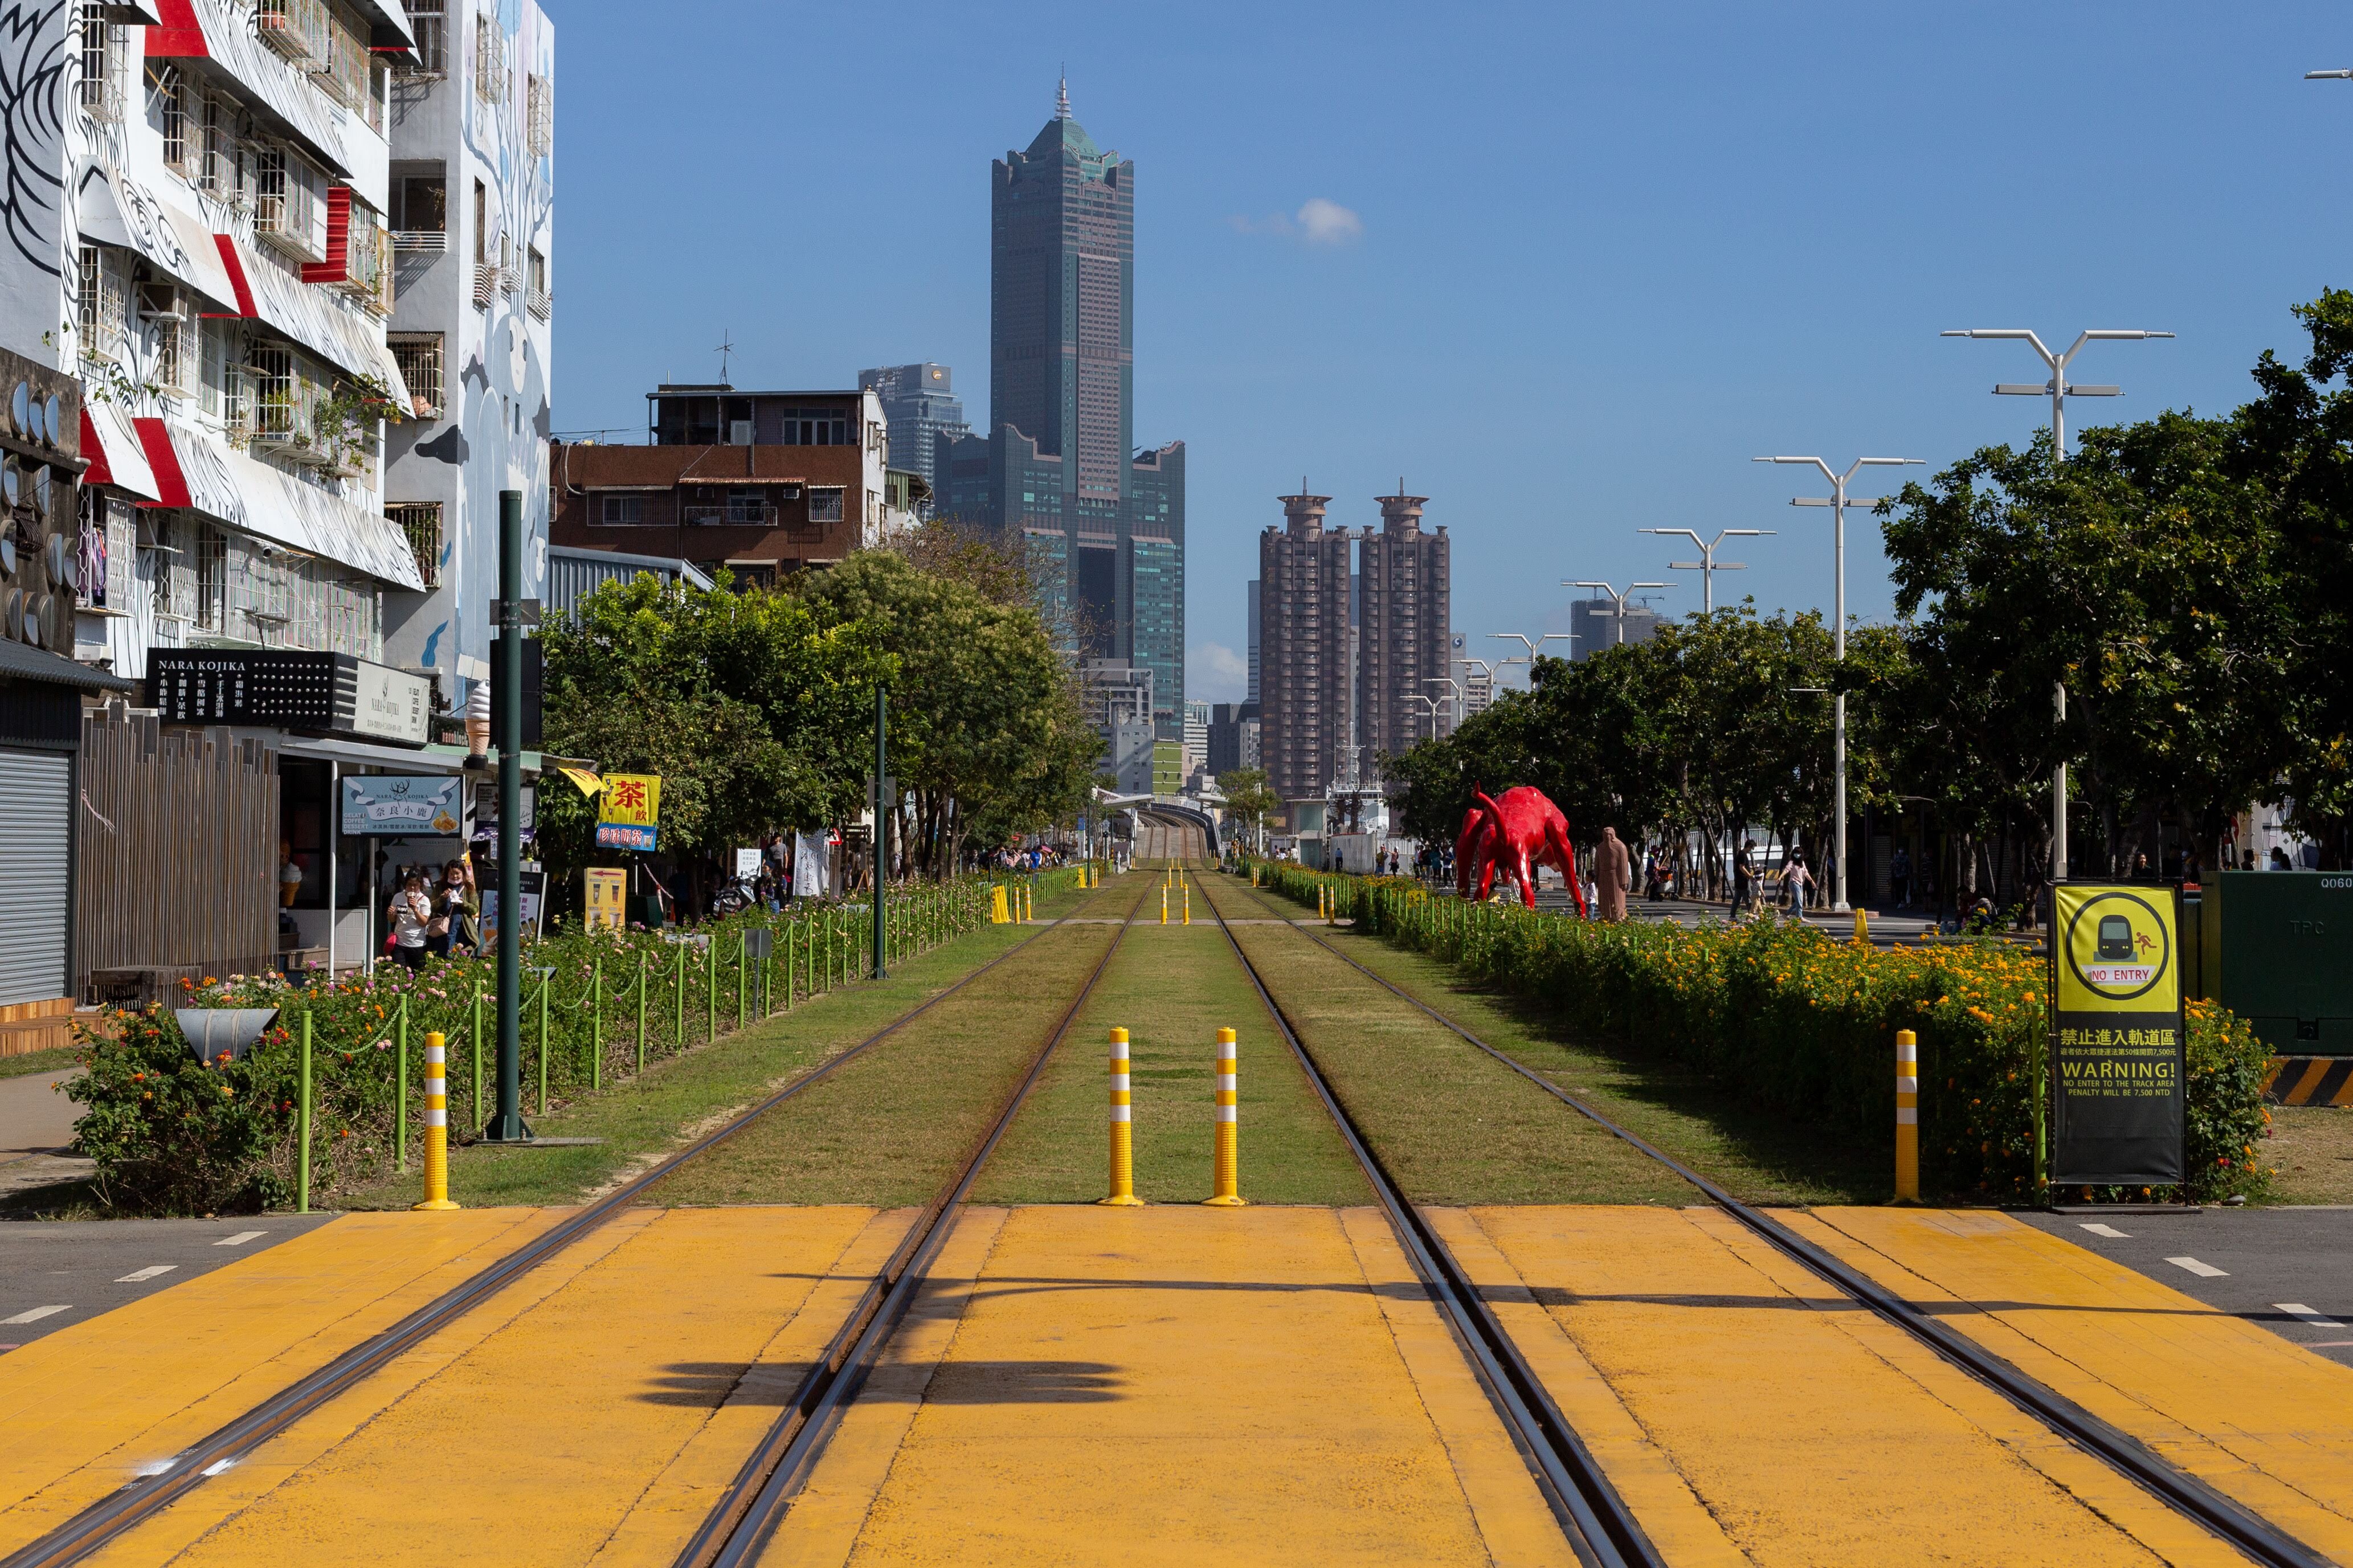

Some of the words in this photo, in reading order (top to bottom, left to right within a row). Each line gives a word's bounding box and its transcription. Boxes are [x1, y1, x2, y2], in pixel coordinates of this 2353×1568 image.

[158, 660, 194, 670] NARA
[198, 661, 246, 672] KOJIKA
[371, 698, 382, 712] NARA
[386, 701, 399, 718] KOJIKA
[614, 780, 647, 808] 茶
[375, 805, 427, 817] 奈良小鹿
[635, 810, 647, 821] 飲
[599, 828, 643, 846] 珍珠奶茶
[2321, 878, 2352, 888] Q060
[2289, 920, 2324, 934] TPC
[2091, 970, 2106, 980] NO
[2114, 969, 2150, 980] ENTRY
[2060, 1028, 2176, 1046] 禁止進入軌道區
[2061, 1062, 2175, 1078] WARNING!
